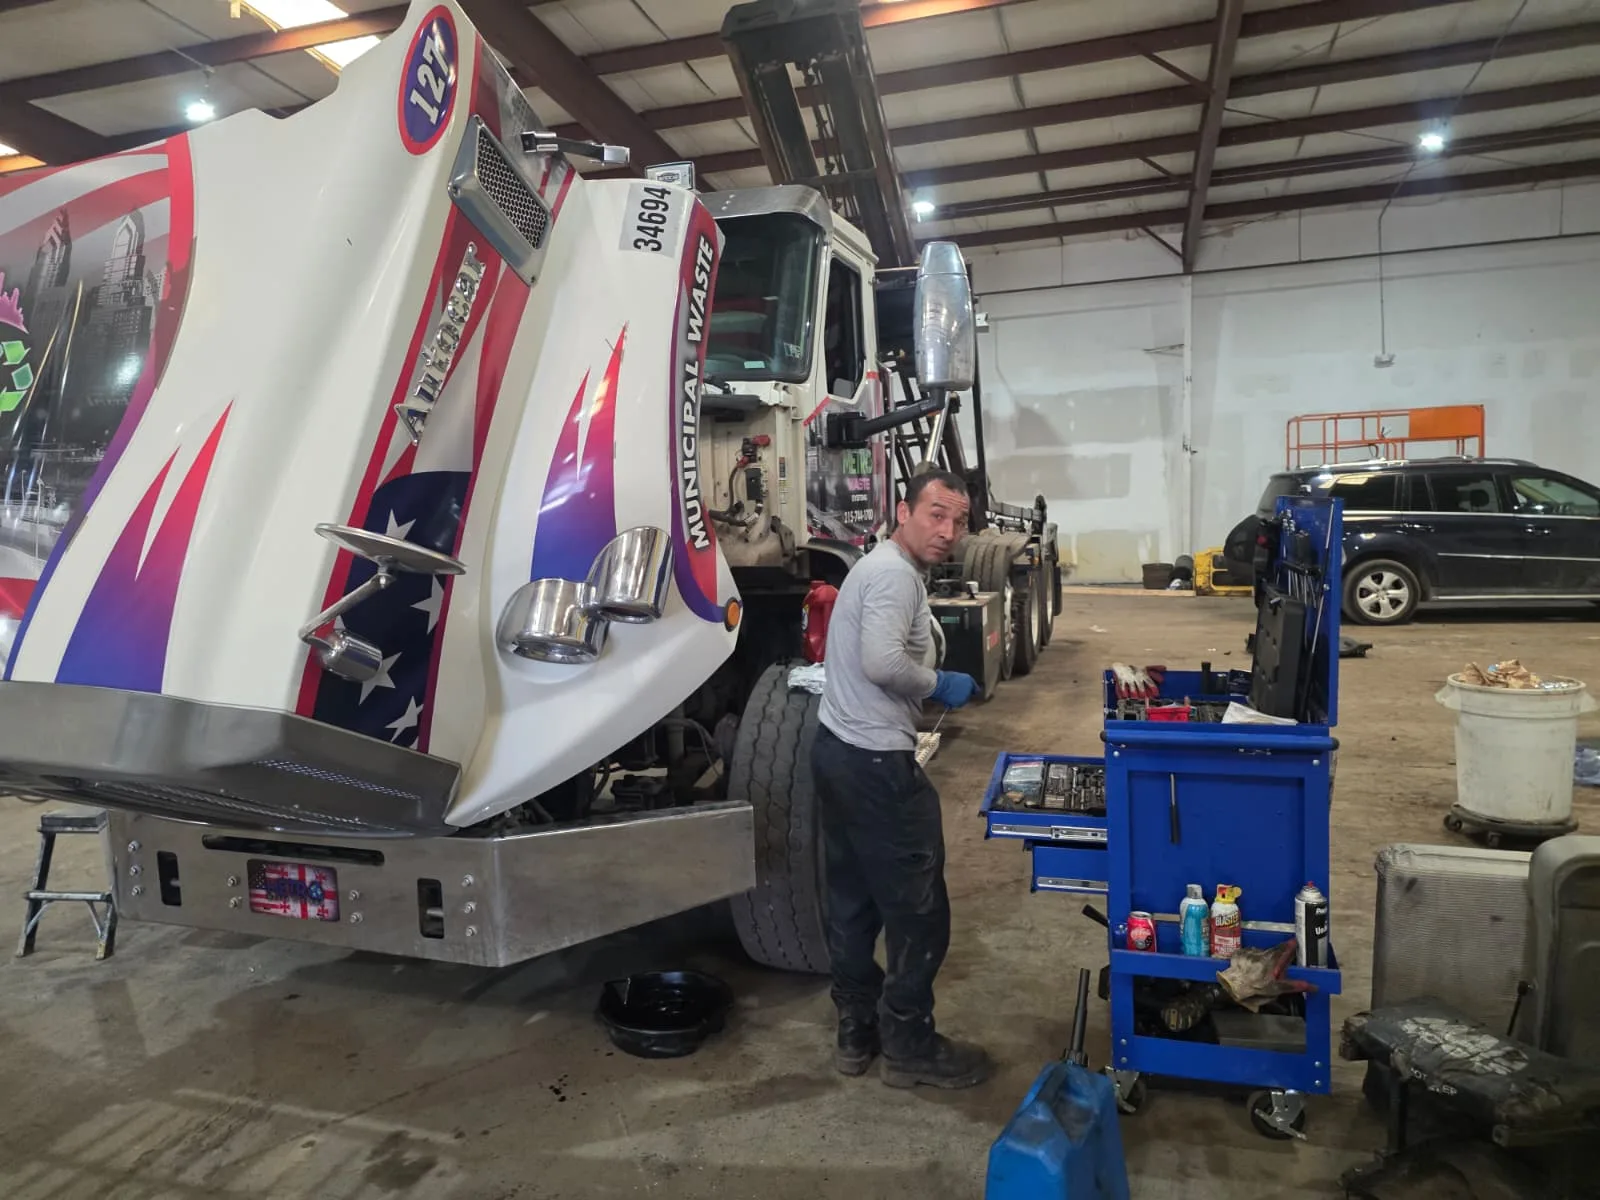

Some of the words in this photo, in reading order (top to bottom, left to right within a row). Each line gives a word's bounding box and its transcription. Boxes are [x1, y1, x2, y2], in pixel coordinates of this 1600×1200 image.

[410, 35, 449, 125] 127
[633, 186, 671, 252] 34694
[687, 236, 714, 343] WASTE
[682, 360, 710, 550] MUNICIPAL
